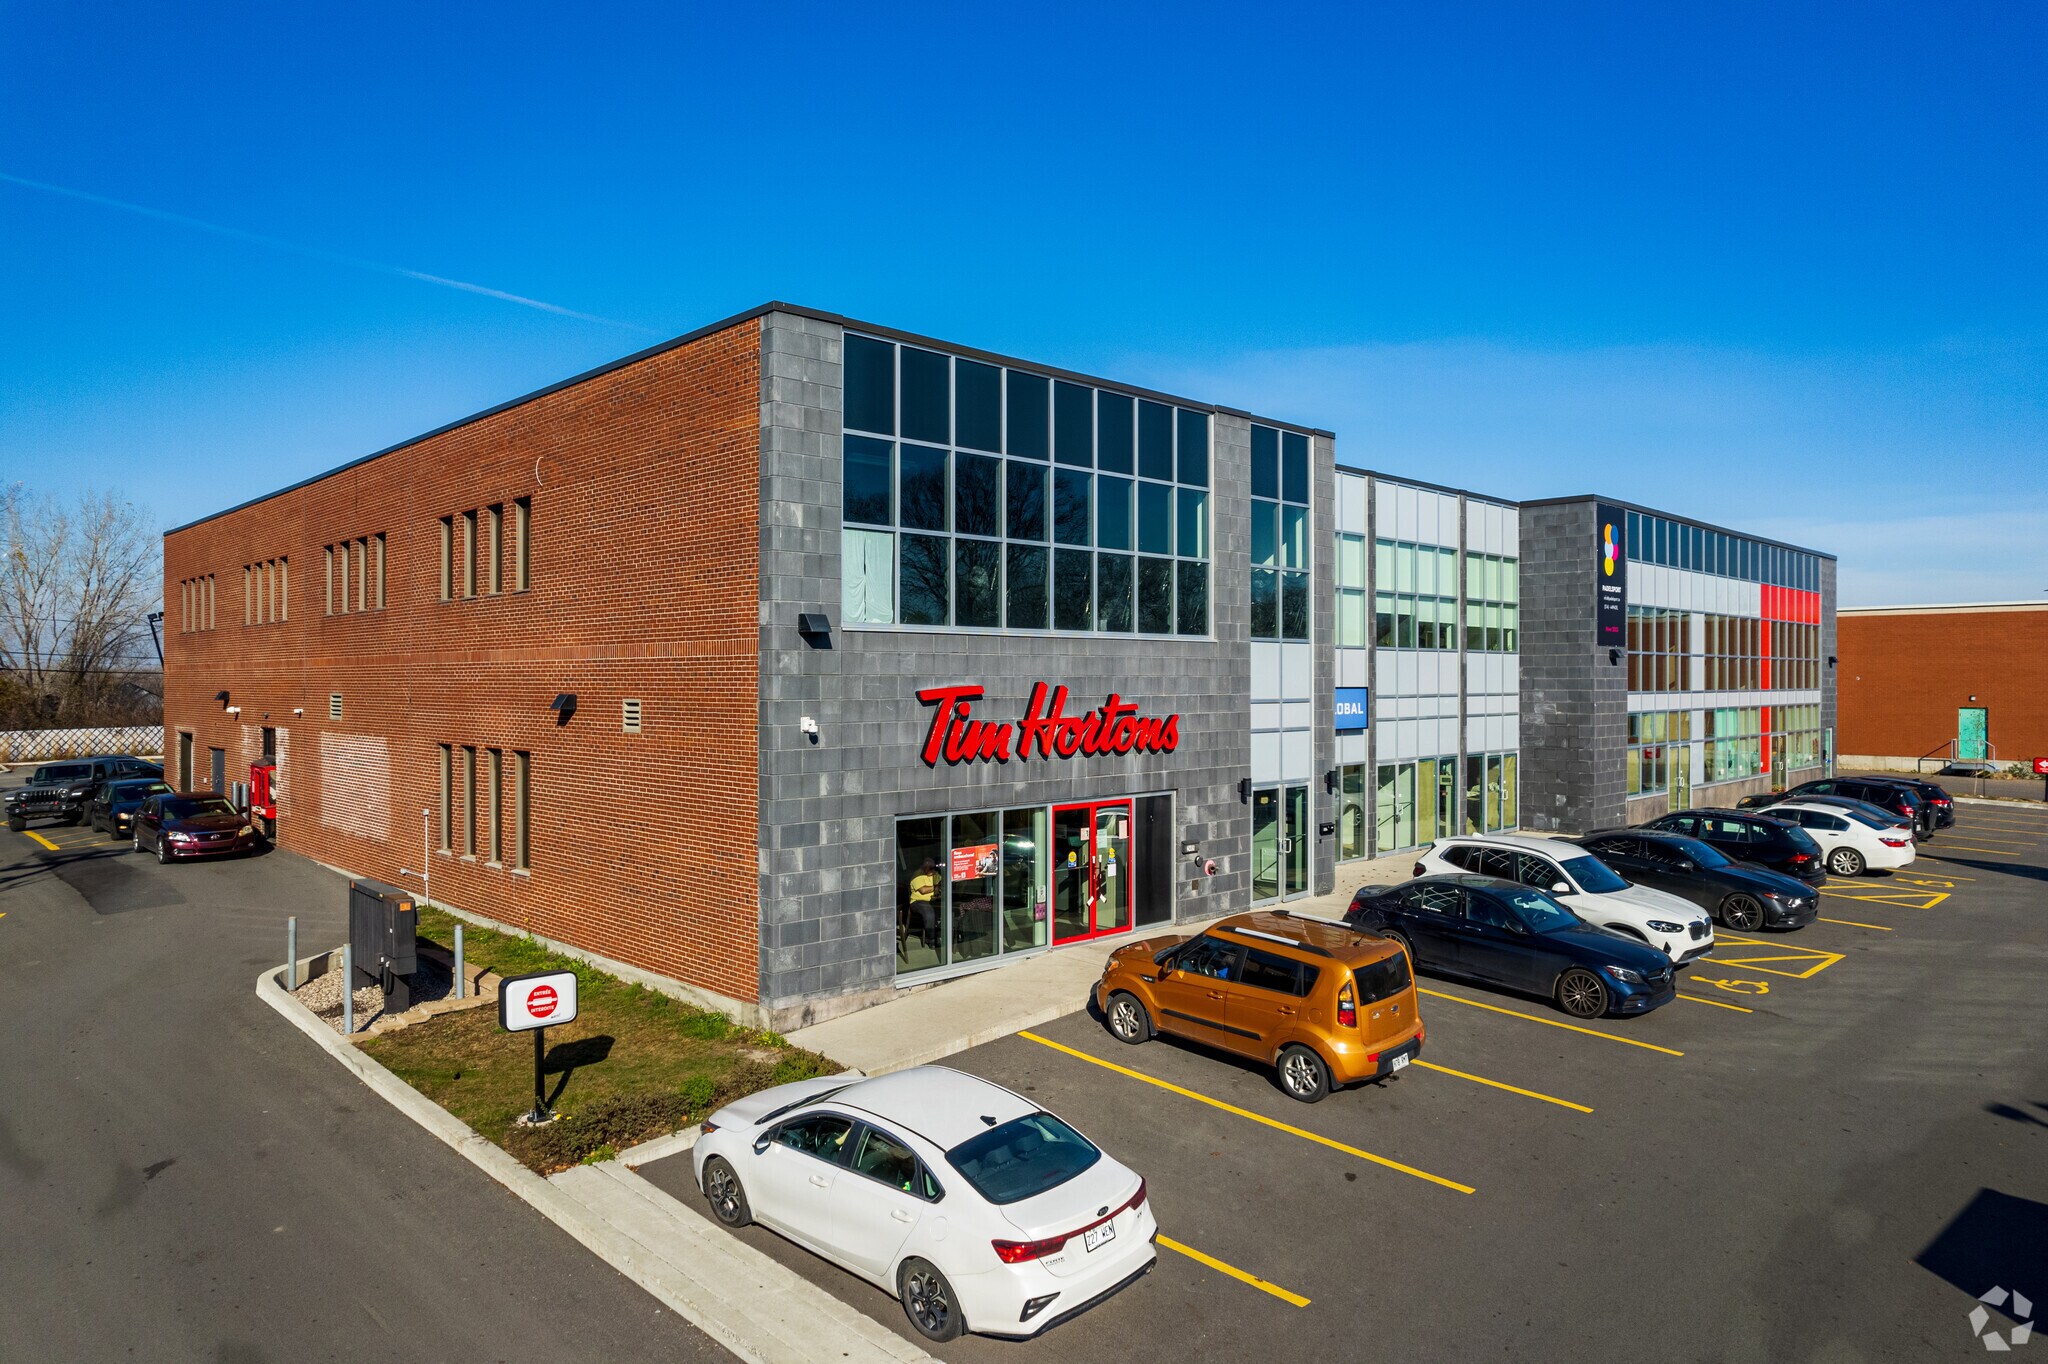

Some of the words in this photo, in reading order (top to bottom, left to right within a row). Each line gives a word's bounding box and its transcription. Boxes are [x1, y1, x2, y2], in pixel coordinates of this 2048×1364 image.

[1335, 702, 1364, 715] OBAL
[915, 685, 1012, 768] Tim
[1016, 681, 1180, 761] Hortons
[531, 1005, 555, 1013] INTERDITE
